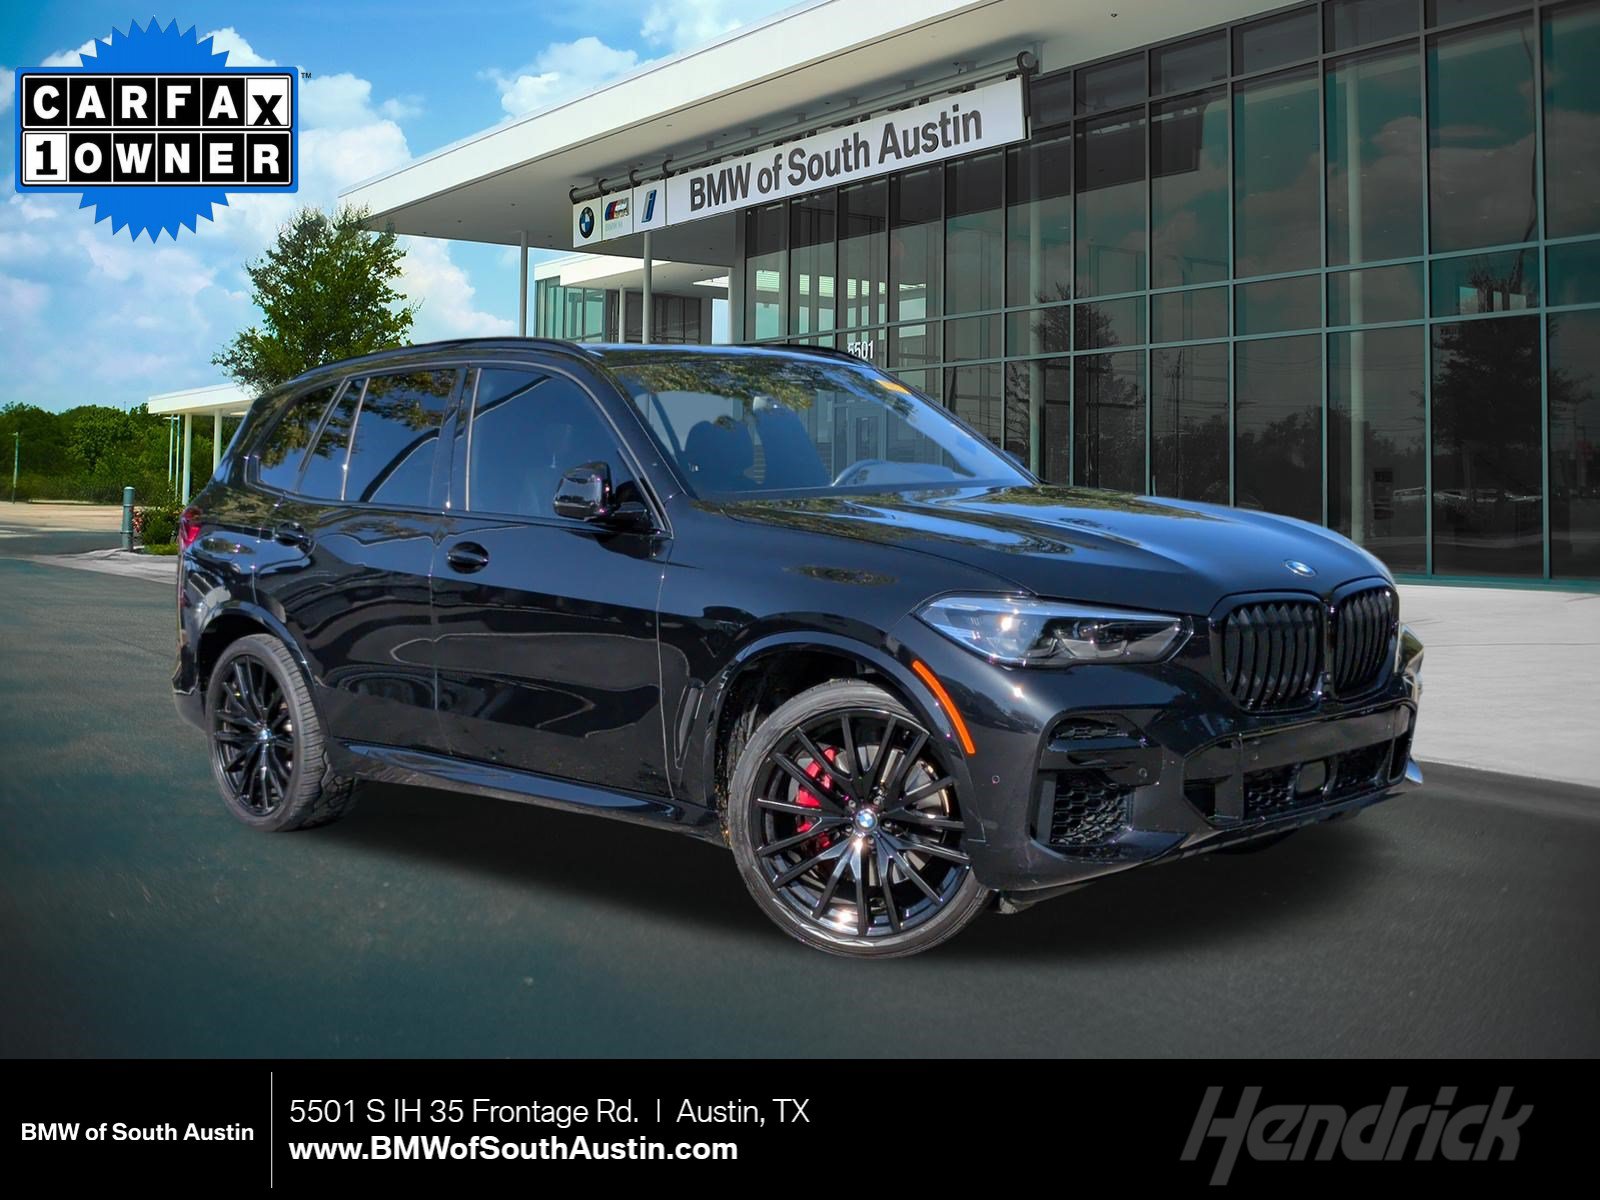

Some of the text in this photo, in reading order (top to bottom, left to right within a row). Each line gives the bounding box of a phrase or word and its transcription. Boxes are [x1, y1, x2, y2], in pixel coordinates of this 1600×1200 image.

[689, 104, 983, 212] BMW of South Austin
[847, 340, 874, 360] 5501
